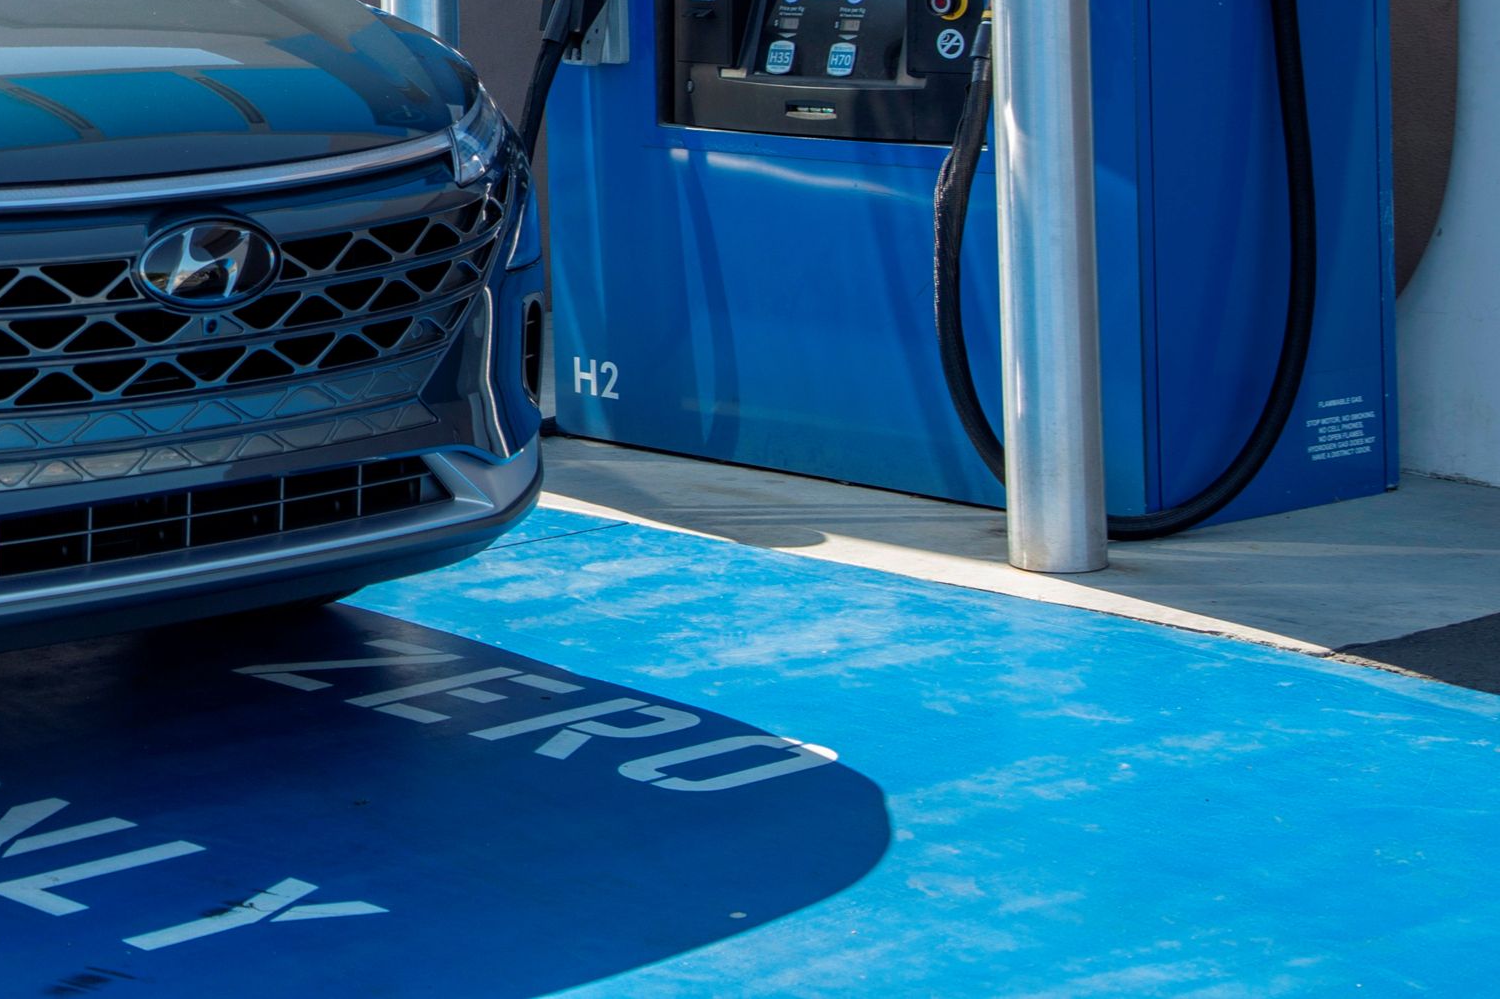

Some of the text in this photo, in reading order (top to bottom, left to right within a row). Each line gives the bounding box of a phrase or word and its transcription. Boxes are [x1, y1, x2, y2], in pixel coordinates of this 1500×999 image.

[770, 51, 790, 63] H35
[830, 54, 852, 66] H70
[574, 356, 619, 399] H2
[232, 638, 839, 791] ZERO
